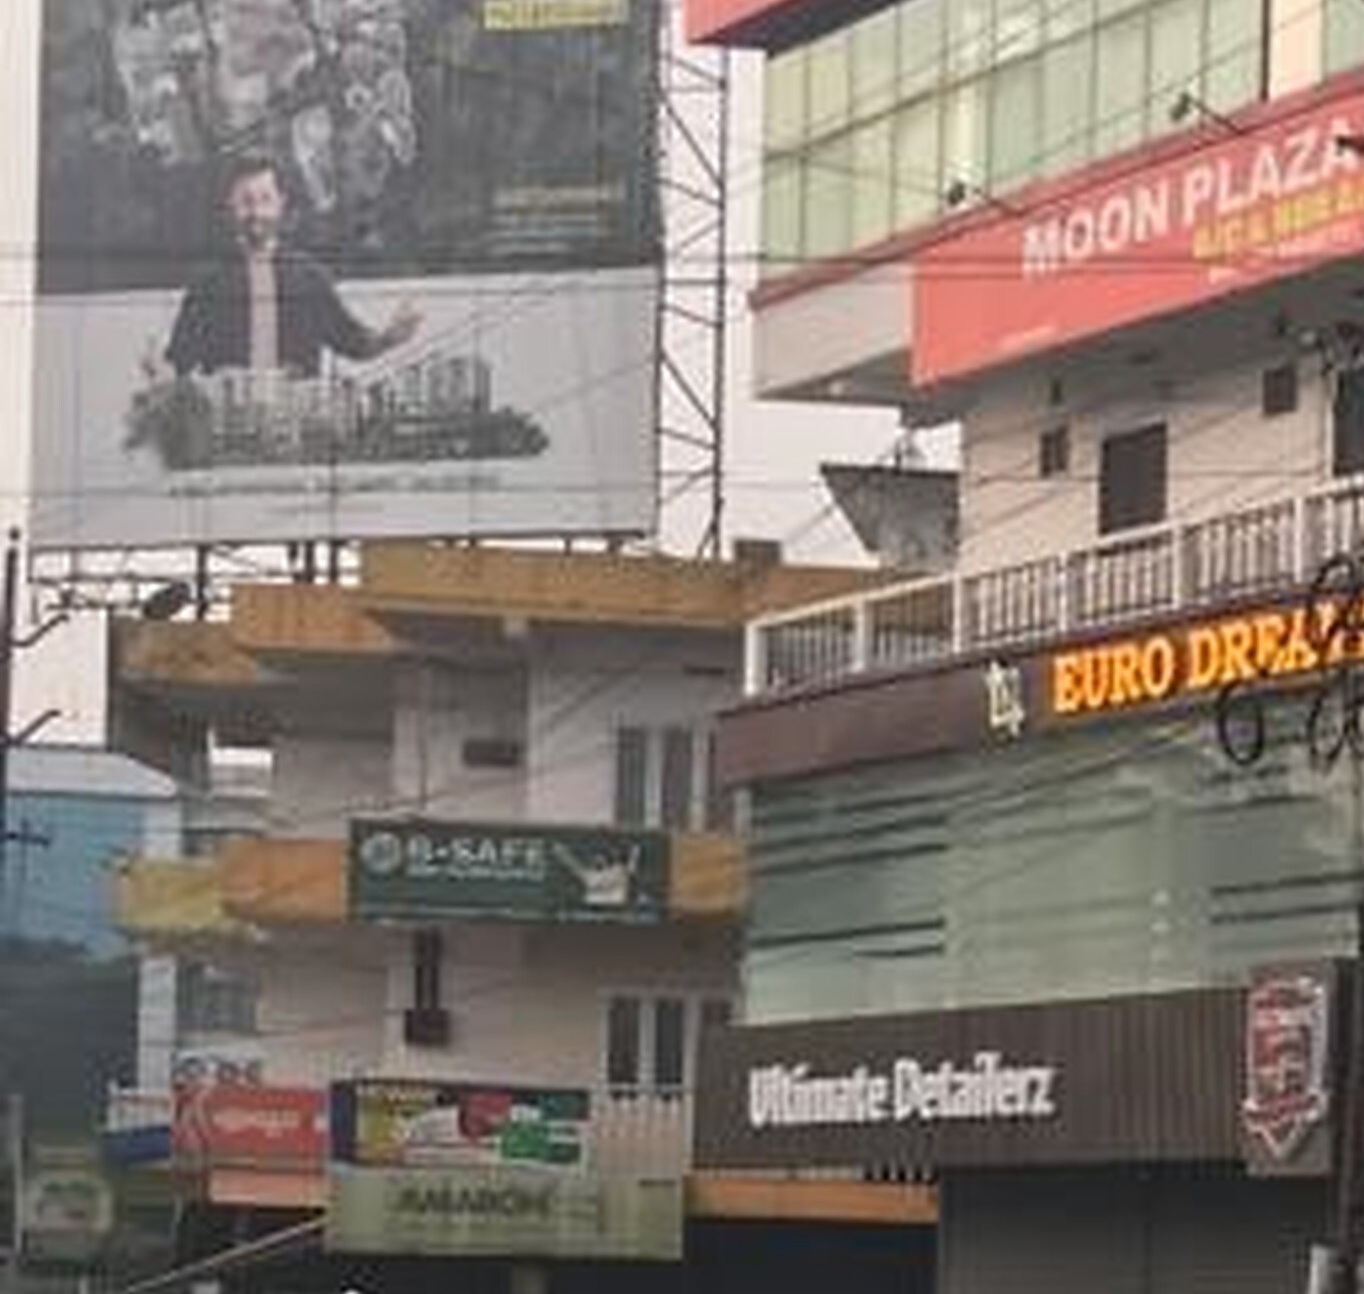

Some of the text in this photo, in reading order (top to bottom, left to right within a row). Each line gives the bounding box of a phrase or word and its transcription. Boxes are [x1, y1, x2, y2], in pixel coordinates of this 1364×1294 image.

[1022, 175, 1171, 282] MOON
[1179, 117, 1358, 229] PLAZA
[1054, 635, 1177, 714] EURO
[750, 1049, 1057, 1129] Ultimate Detailerz
